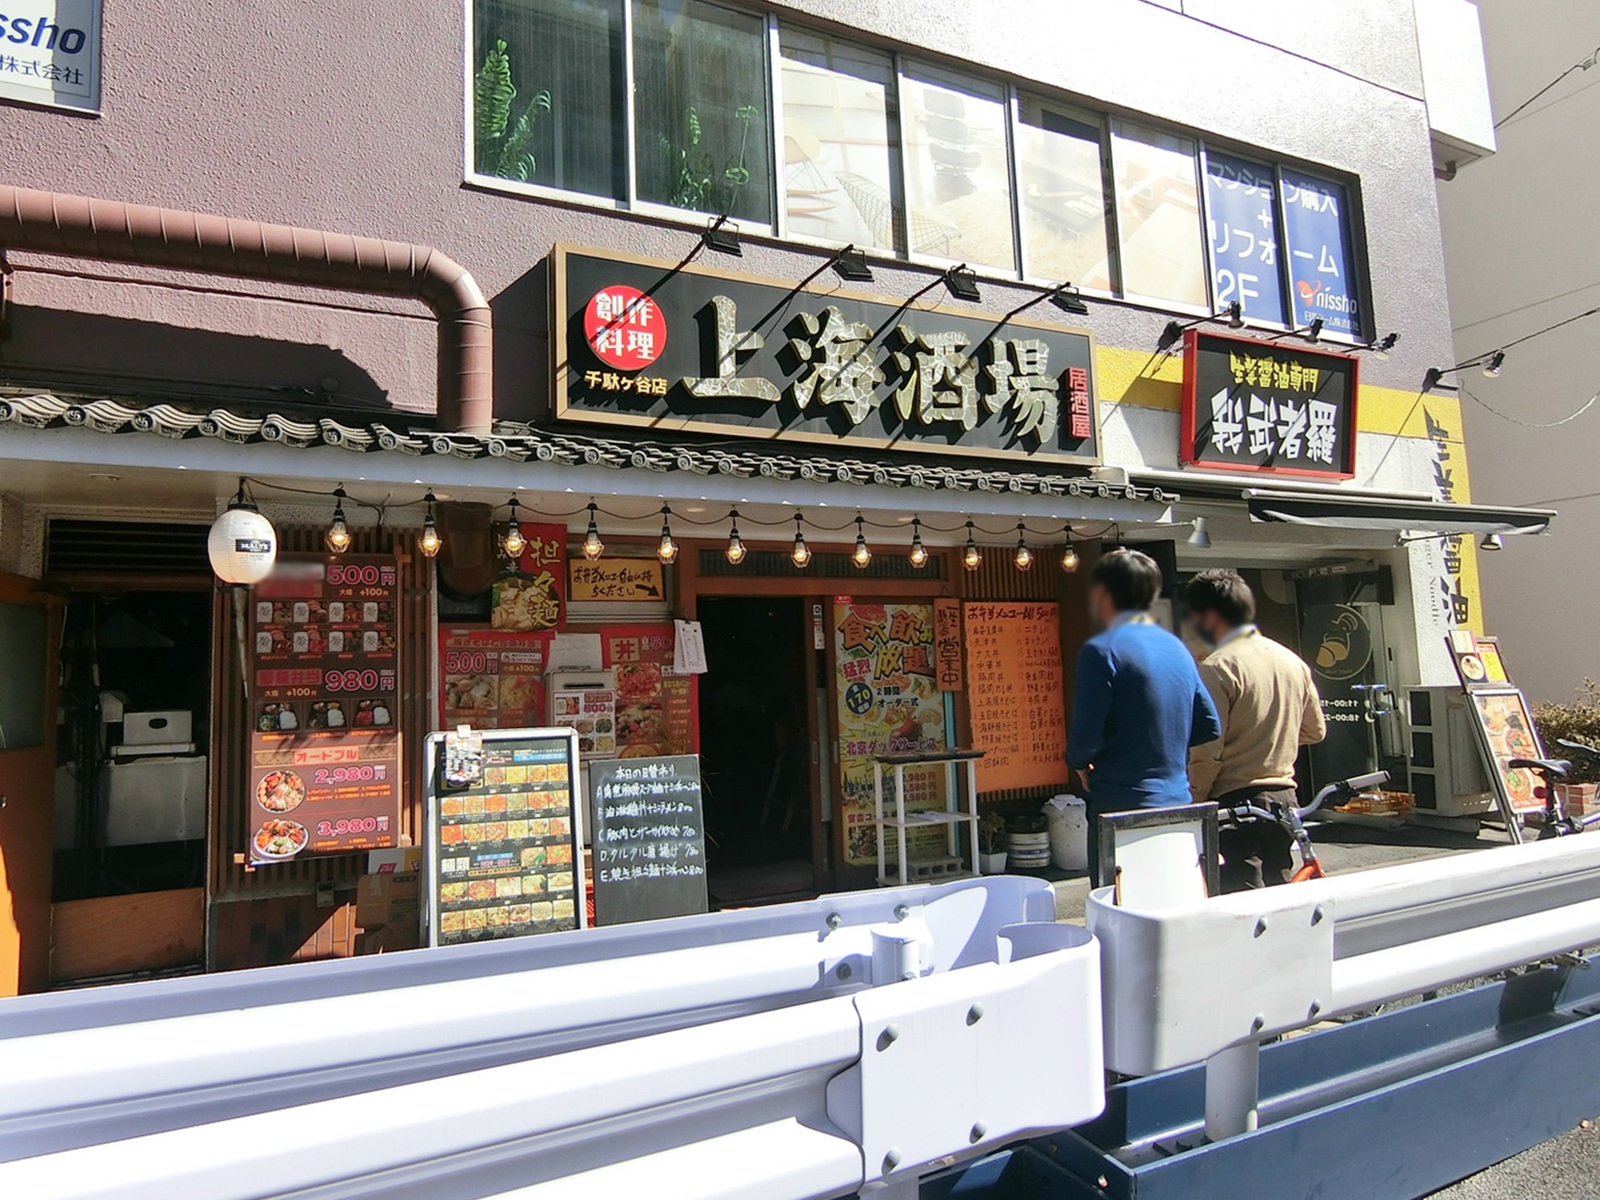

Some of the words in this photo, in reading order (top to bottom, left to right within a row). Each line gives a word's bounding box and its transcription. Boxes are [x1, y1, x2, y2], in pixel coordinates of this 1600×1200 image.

[596, 292, 654, 327] 創作
[1217, 269, 1258, 312] 2F
[1316, 286, 1357, 314] nissho
[596, 326, 655, 360] 料理
[682, 294, 1060, 444] 上海酒場
[1070, 367, 1091, 438] 居酒屋
